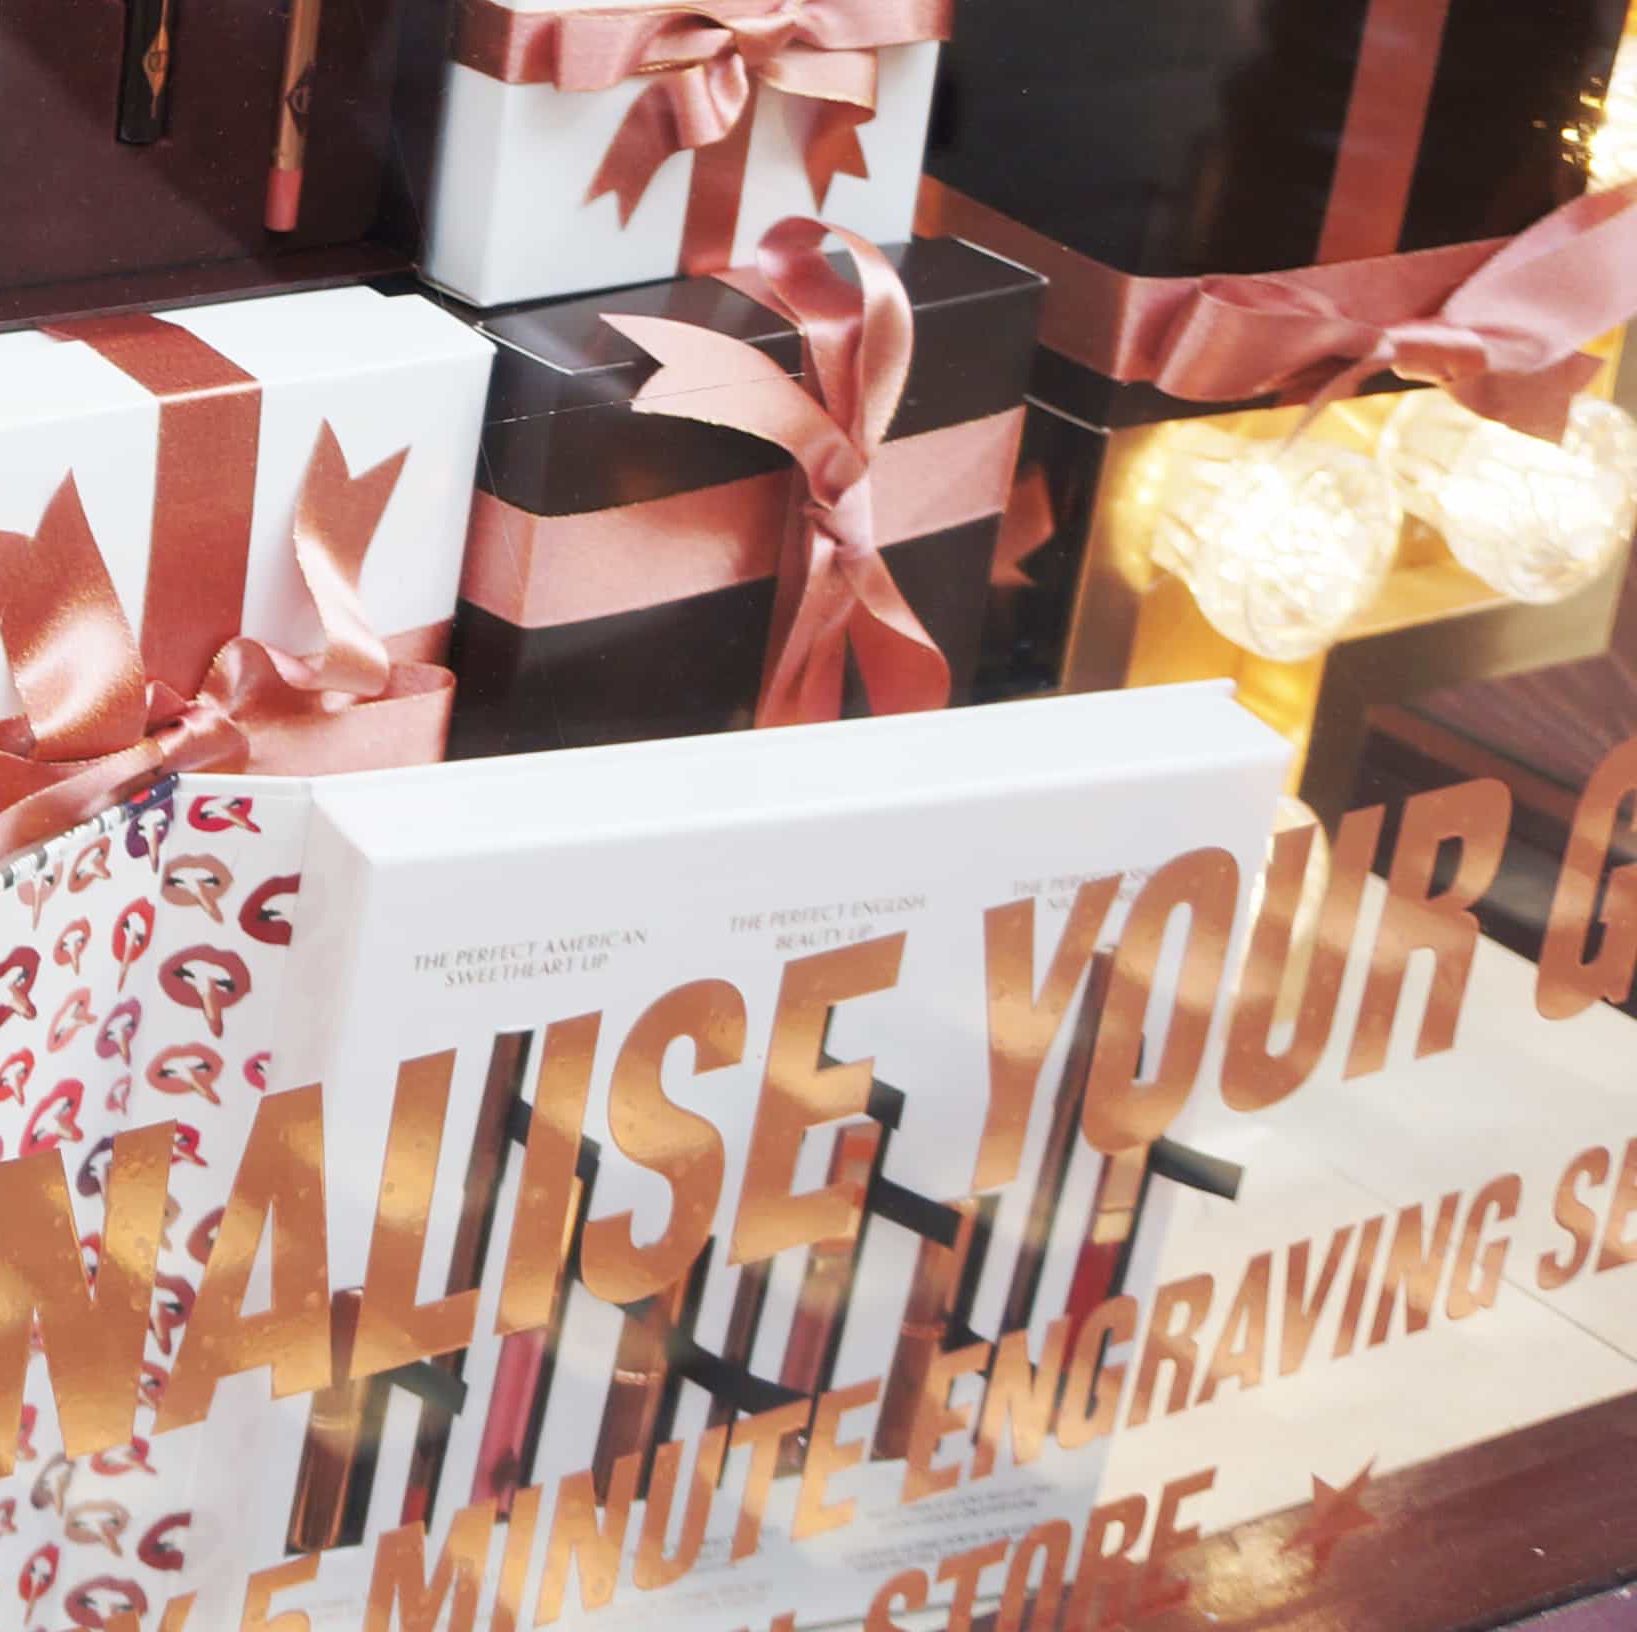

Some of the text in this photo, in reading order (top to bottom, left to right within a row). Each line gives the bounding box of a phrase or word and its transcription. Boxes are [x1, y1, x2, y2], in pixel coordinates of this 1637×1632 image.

[730, 893, 927, 933] THE PERFECT ENGLISH
[413, 927, 648, 972] THE PERFECT AMERICAN
[444, 952, 610, 988] SWEETHEART LIP
[971, 776, 1513, 1194] YOUR
[363, 1379, 882, 1632] MINUTE
[899, 1172, 1522, 1506] ENGRAVING
